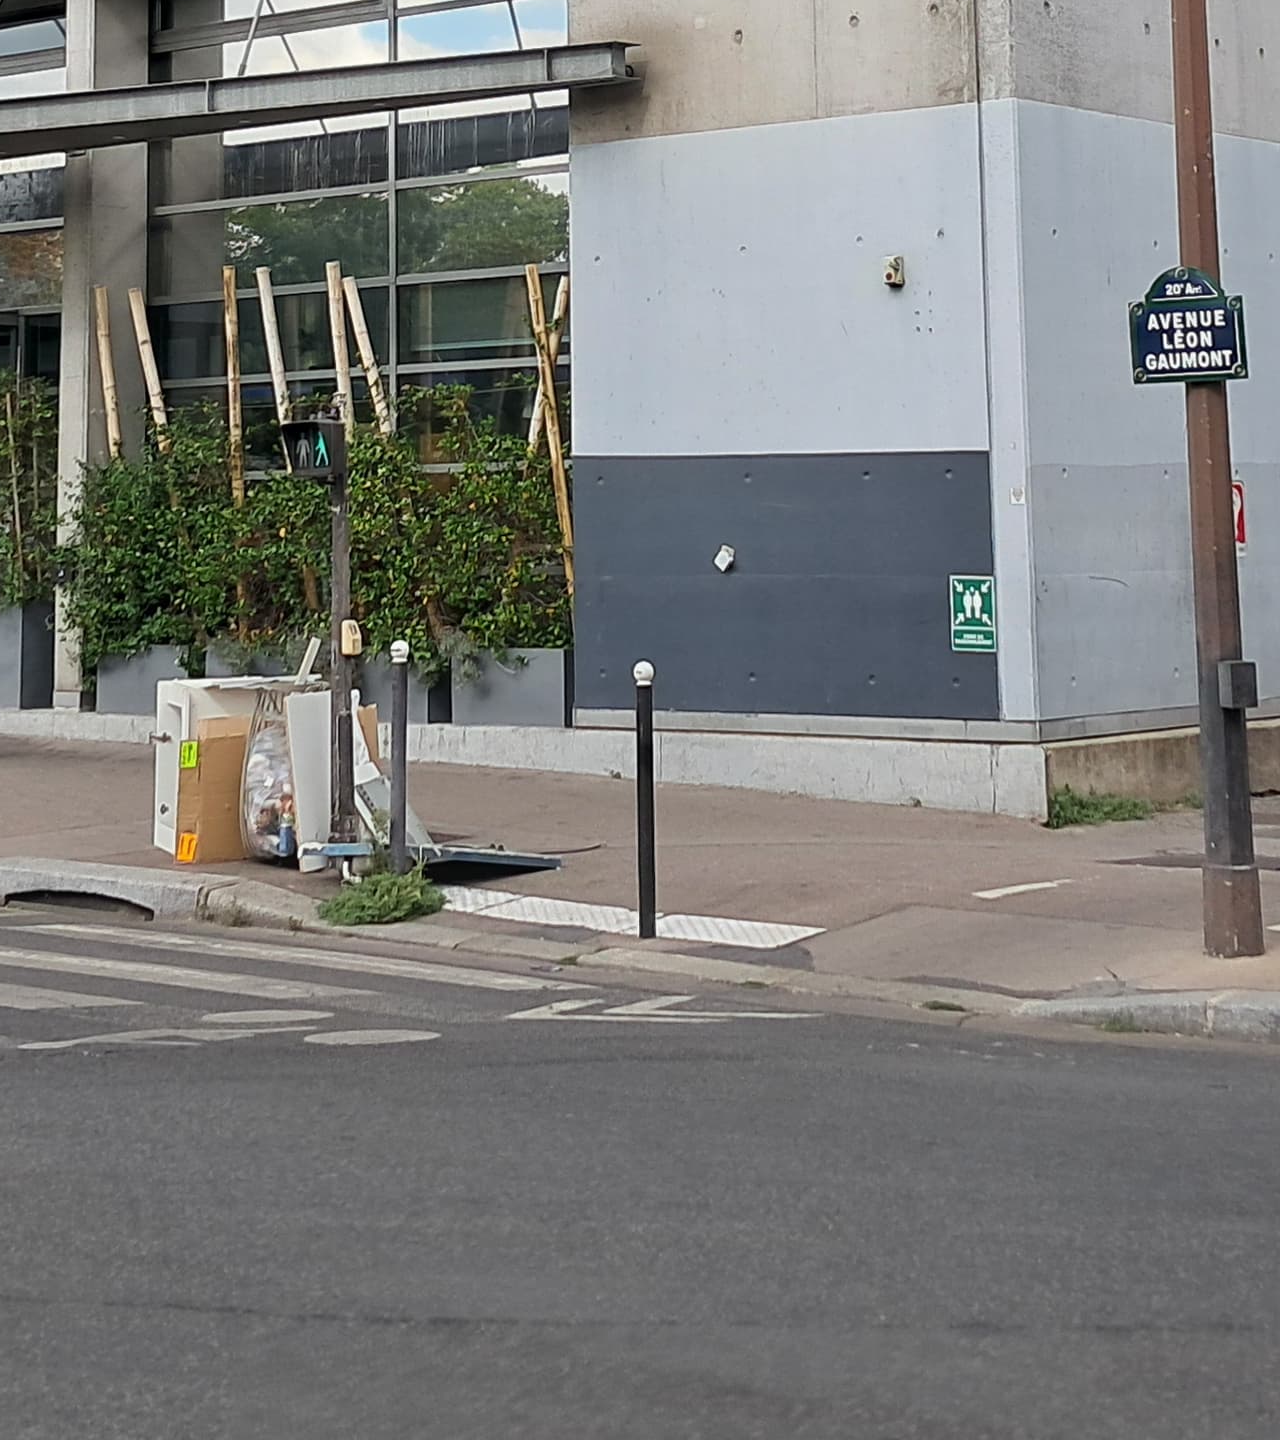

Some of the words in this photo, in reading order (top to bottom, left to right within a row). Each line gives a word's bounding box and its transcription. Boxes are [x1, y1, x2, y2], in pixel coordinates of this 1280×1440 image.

[1147, 309, 1226, 331] AVENUE
[1162, 329, 1213, 350] LÉON
[1145, 349, 1233, 371] GAUMONT
